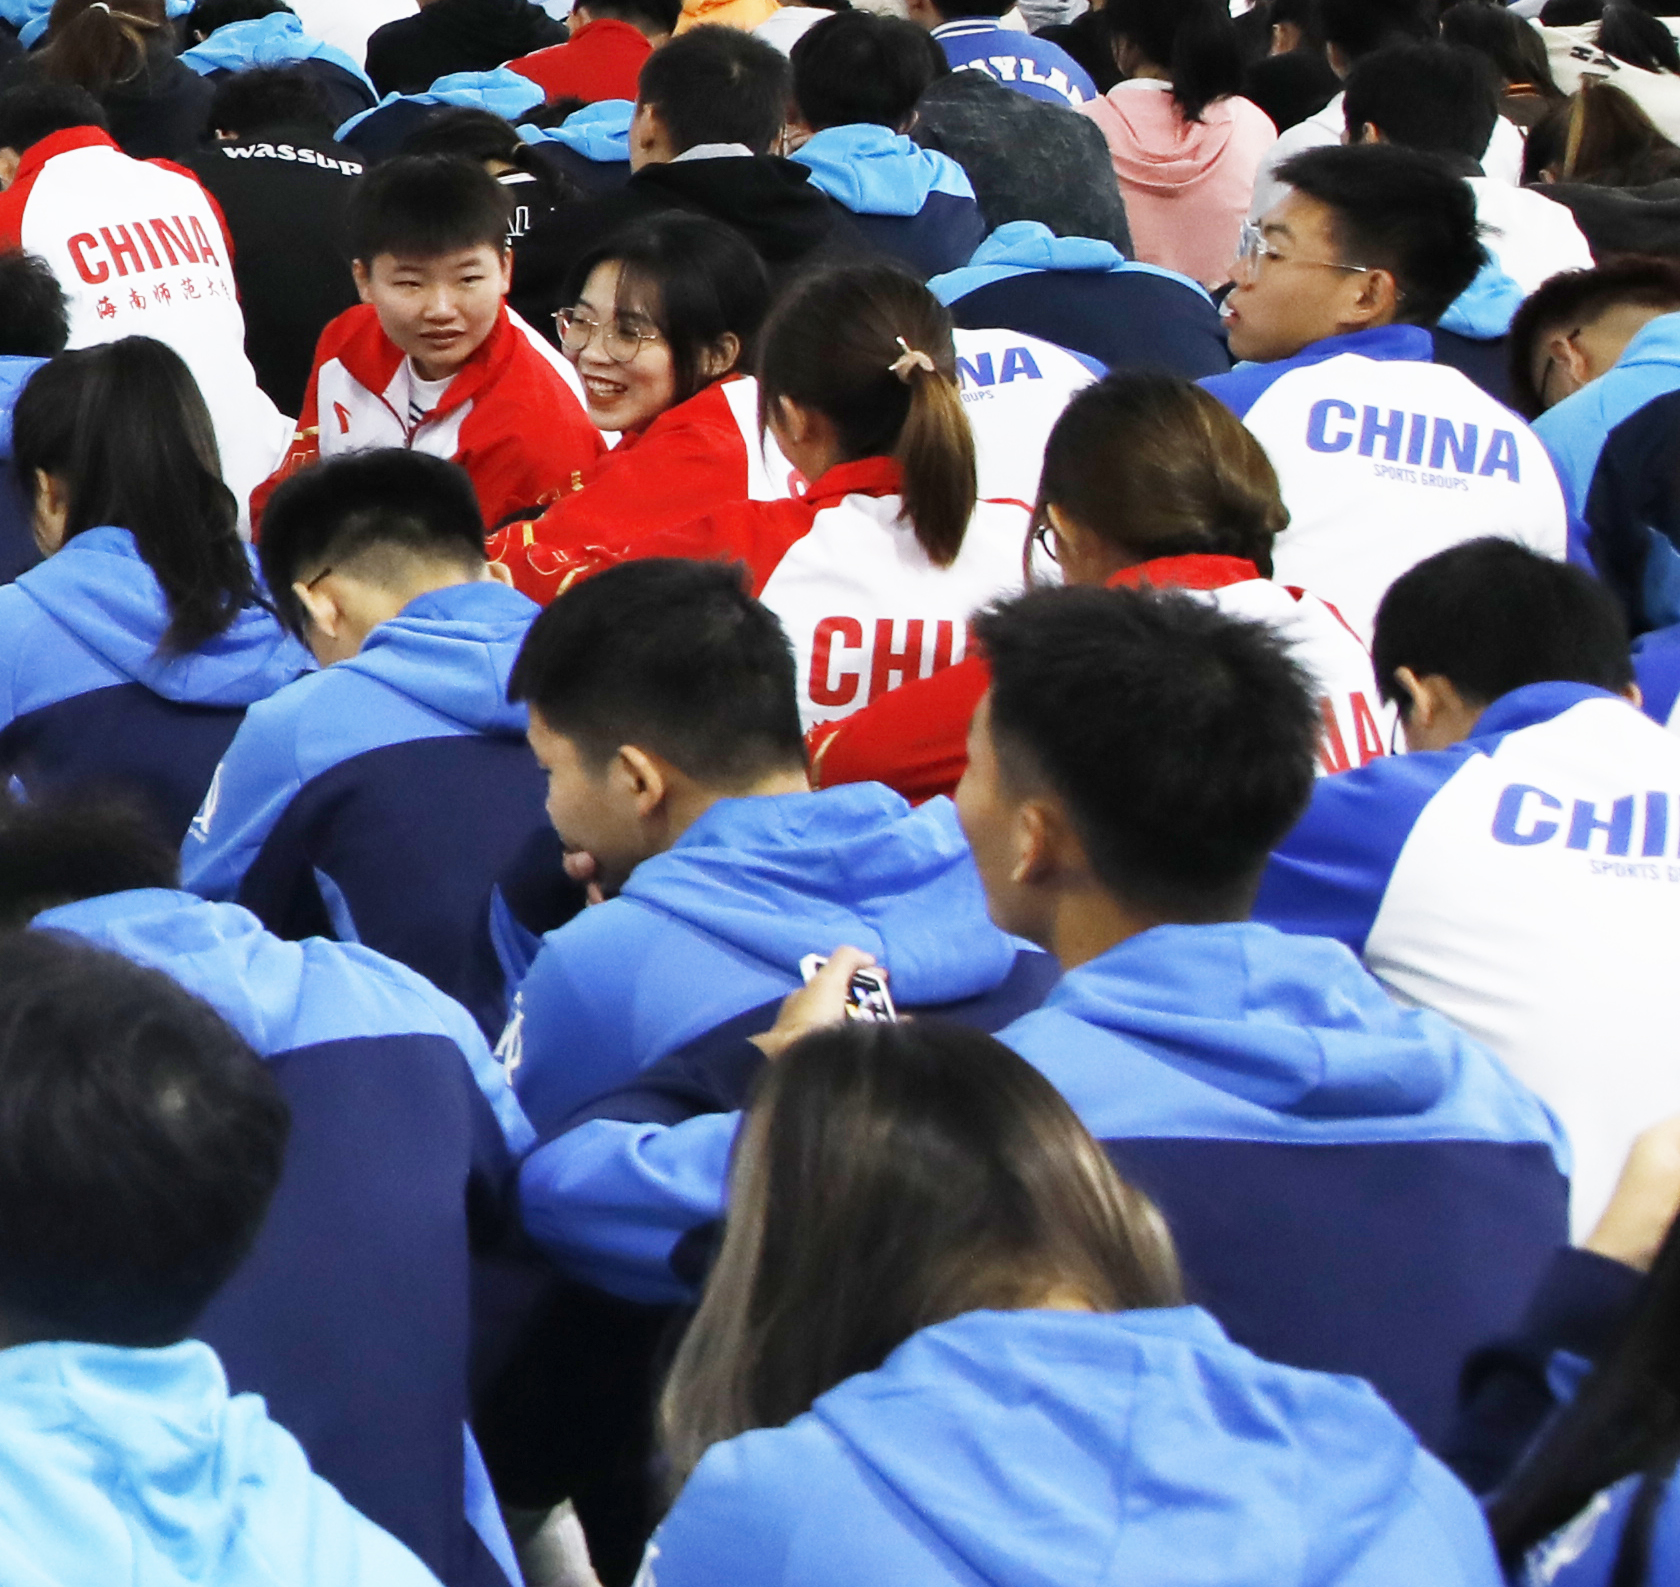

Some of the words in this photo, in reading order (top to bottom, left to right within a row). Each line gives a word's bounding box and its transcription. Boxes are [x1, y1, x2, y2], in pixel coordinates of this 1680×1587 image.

[223, 142, 363, 176] wassup
[67, 214, 220, 285] CHINA
[1306, 397, 1521, 484] CHINA
[1373, 463, 1418, 484] SPORTS
[1420, 469, 1470, 493] GROUPS
[809, 616, 953, 707] CHI
[1491, 783, 1680, 858] CHI
